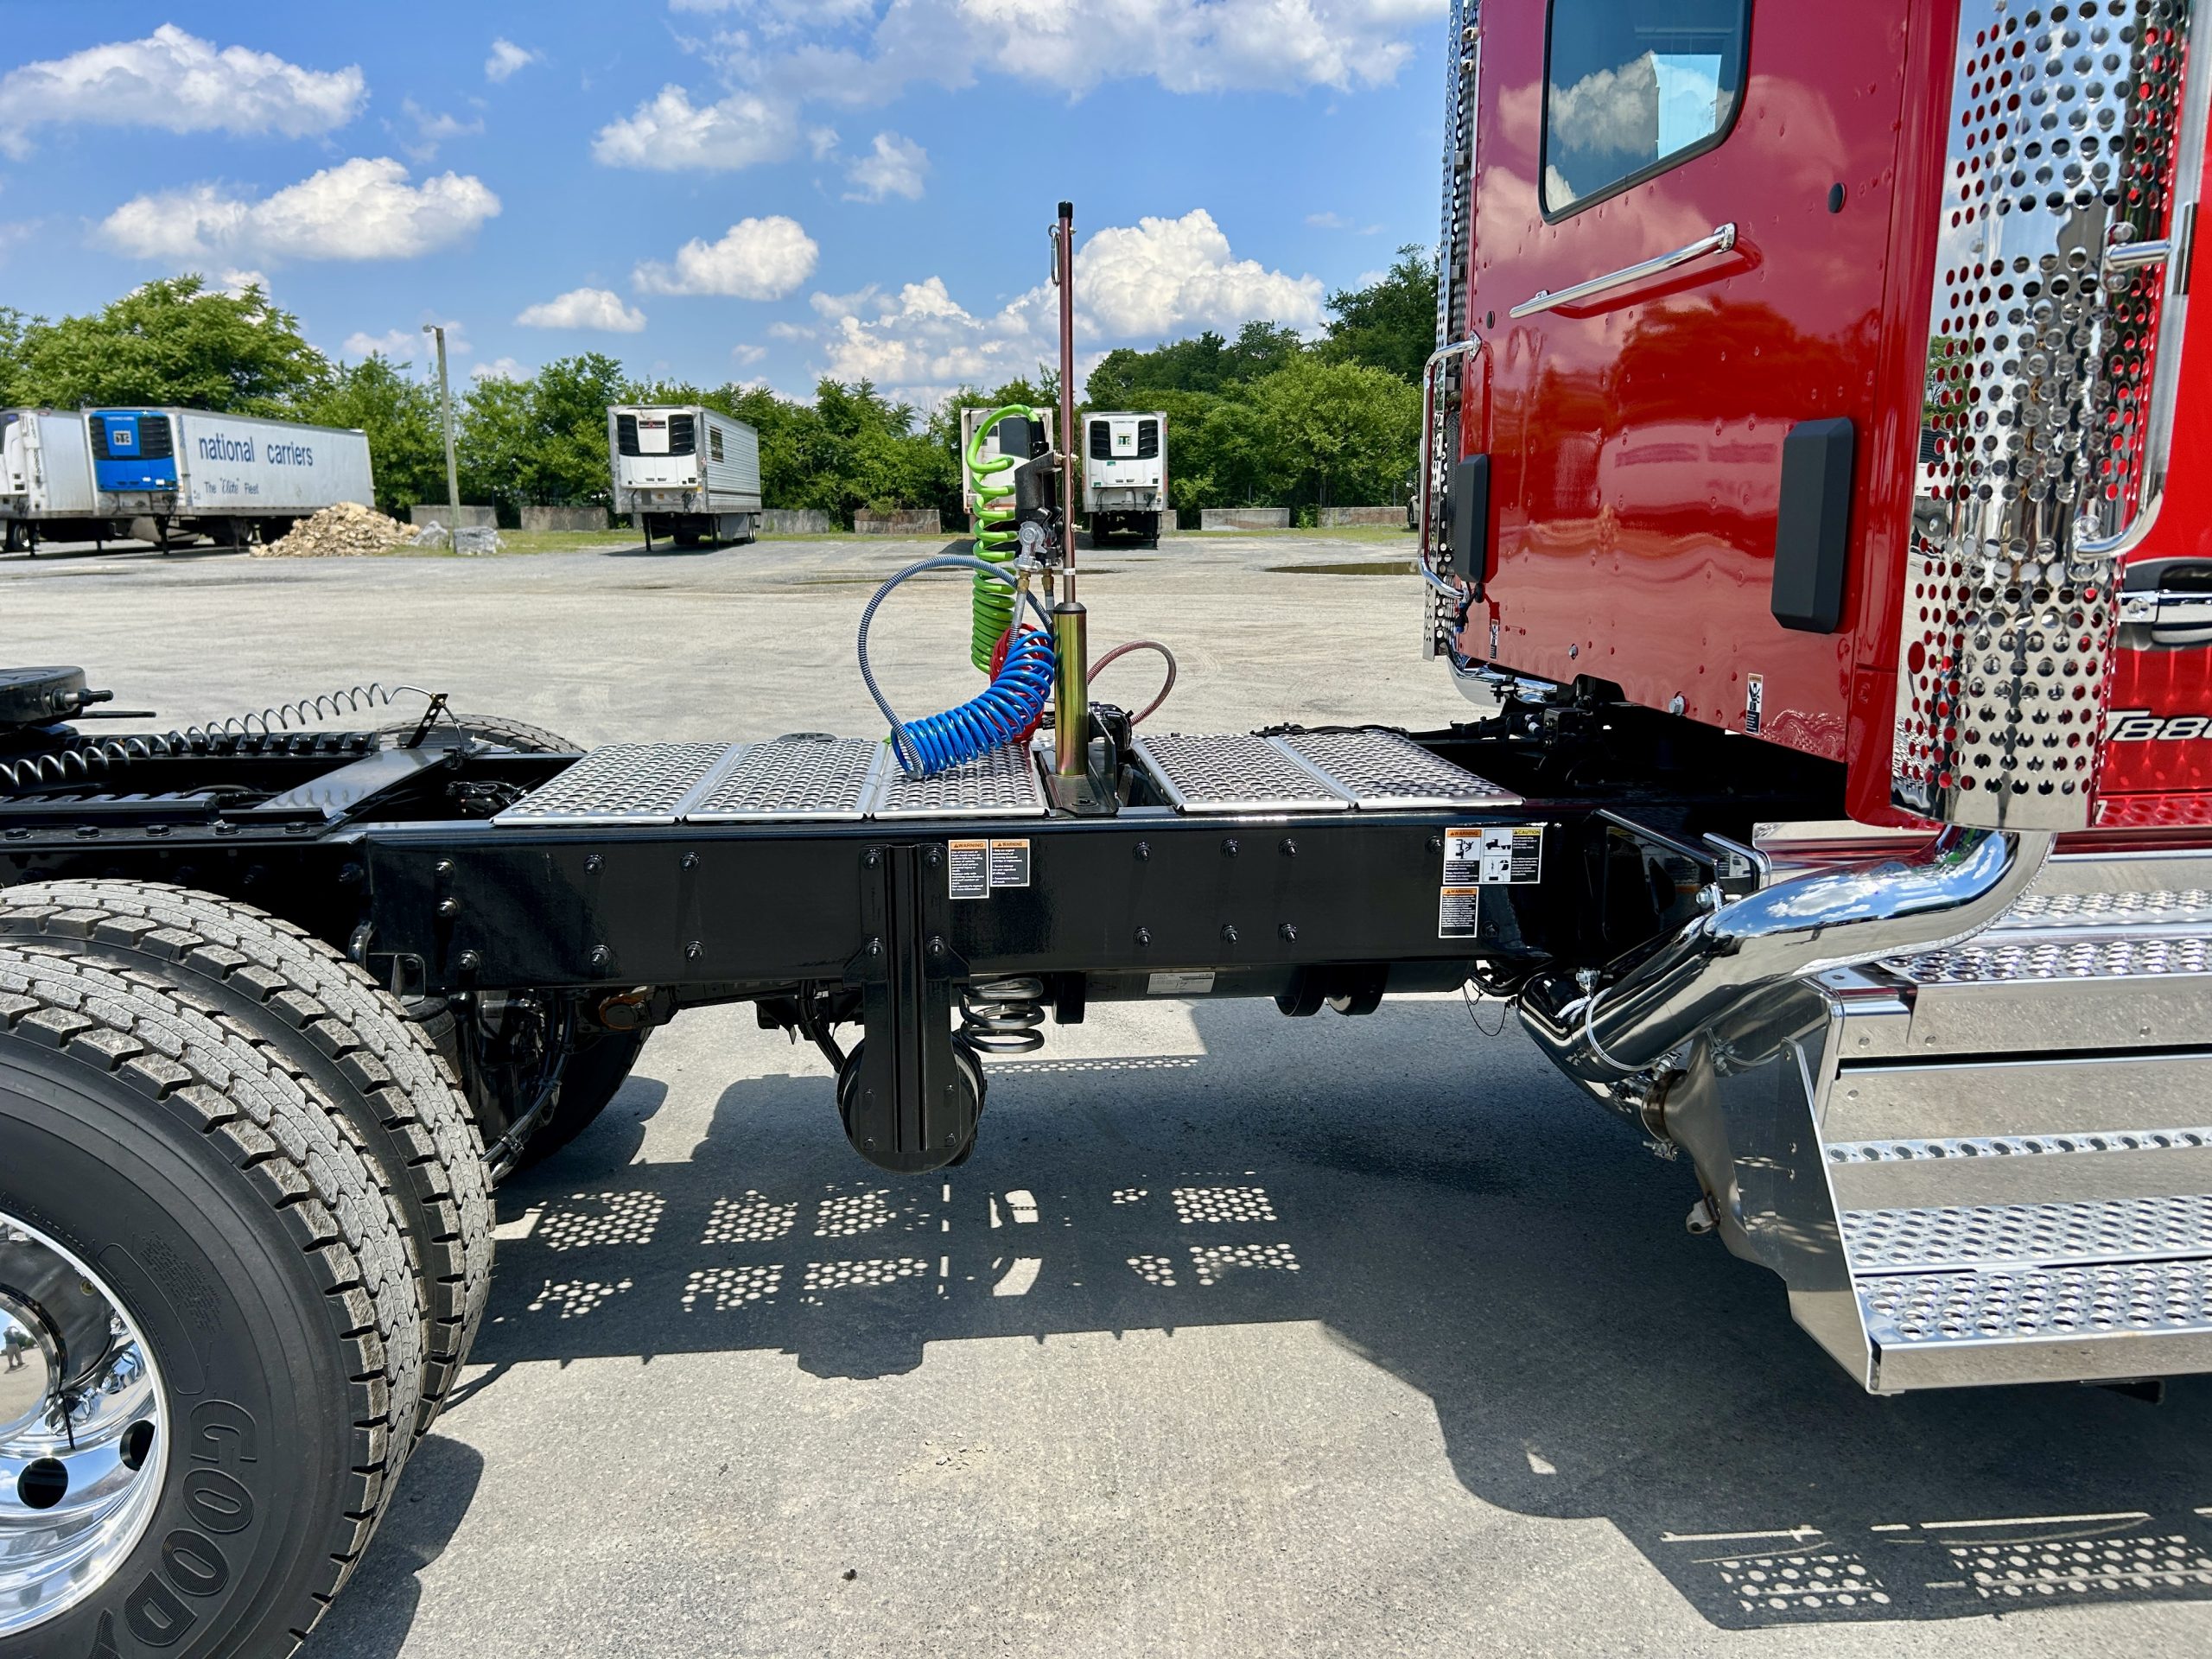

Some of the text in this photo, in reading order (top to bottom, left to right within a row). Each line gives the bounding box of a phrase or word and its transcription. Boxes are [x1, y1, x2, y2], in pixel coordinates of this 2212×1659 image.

[199, 433, 314, 467] national carriers
[2101, 710, 2212, 741] T88
